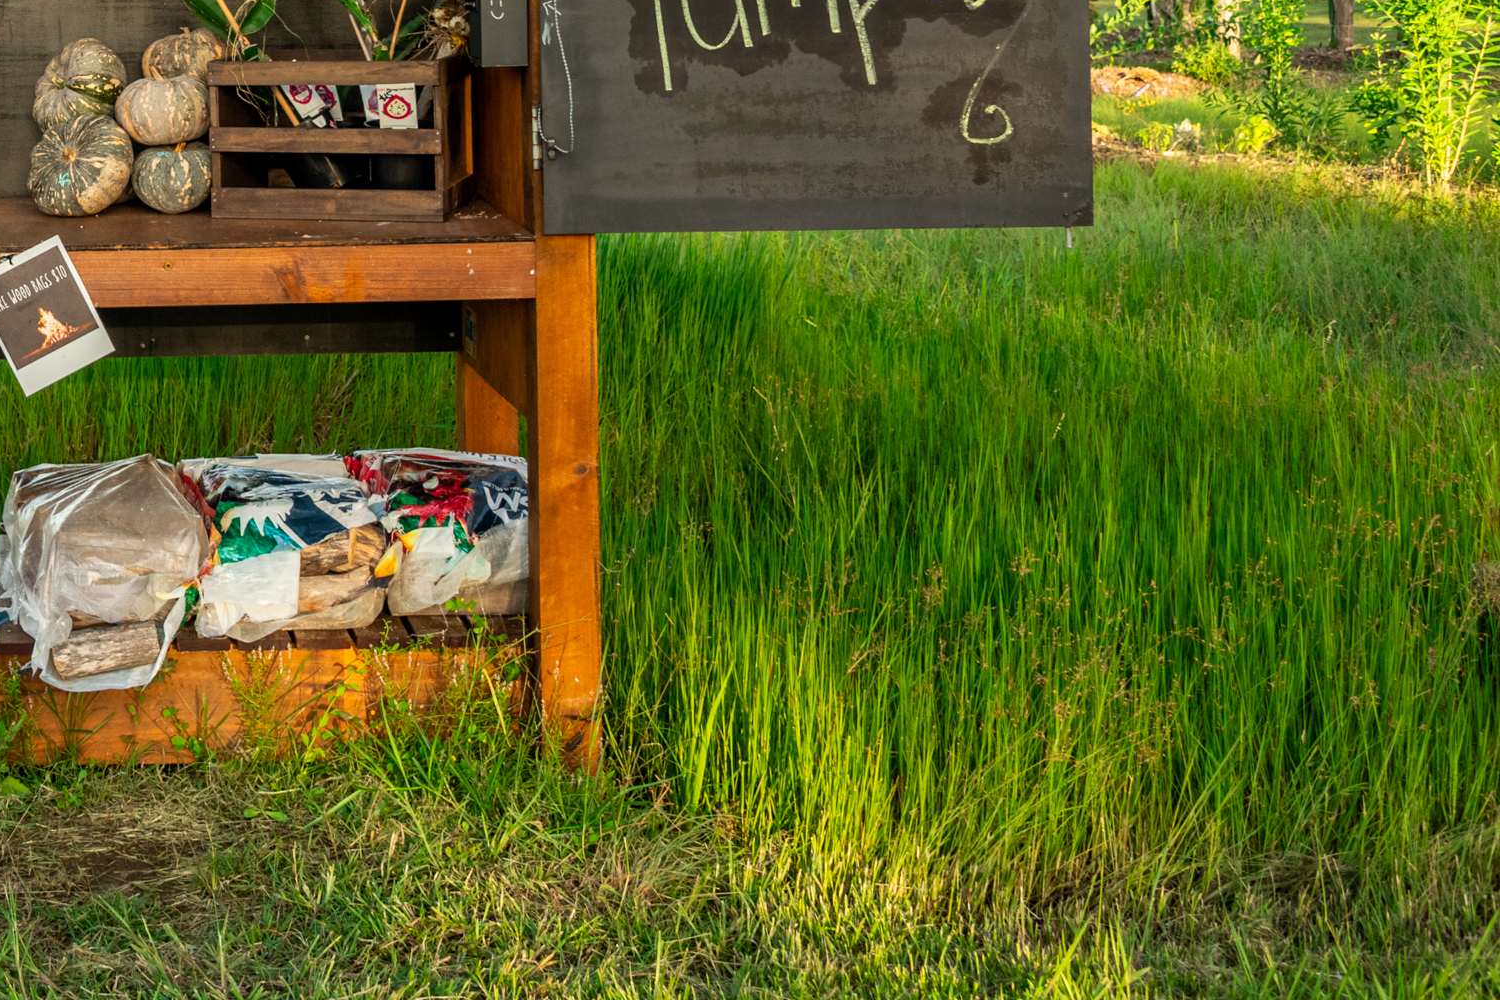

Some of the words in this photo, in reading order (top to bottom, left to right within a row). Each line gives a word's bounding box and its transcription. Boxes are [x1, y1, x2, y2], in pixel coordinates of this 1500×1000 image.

[9, 283, 32, 305] WOOD
[32, 272, 53, 293] BAGS
[51, 264, 68, 283] $10
